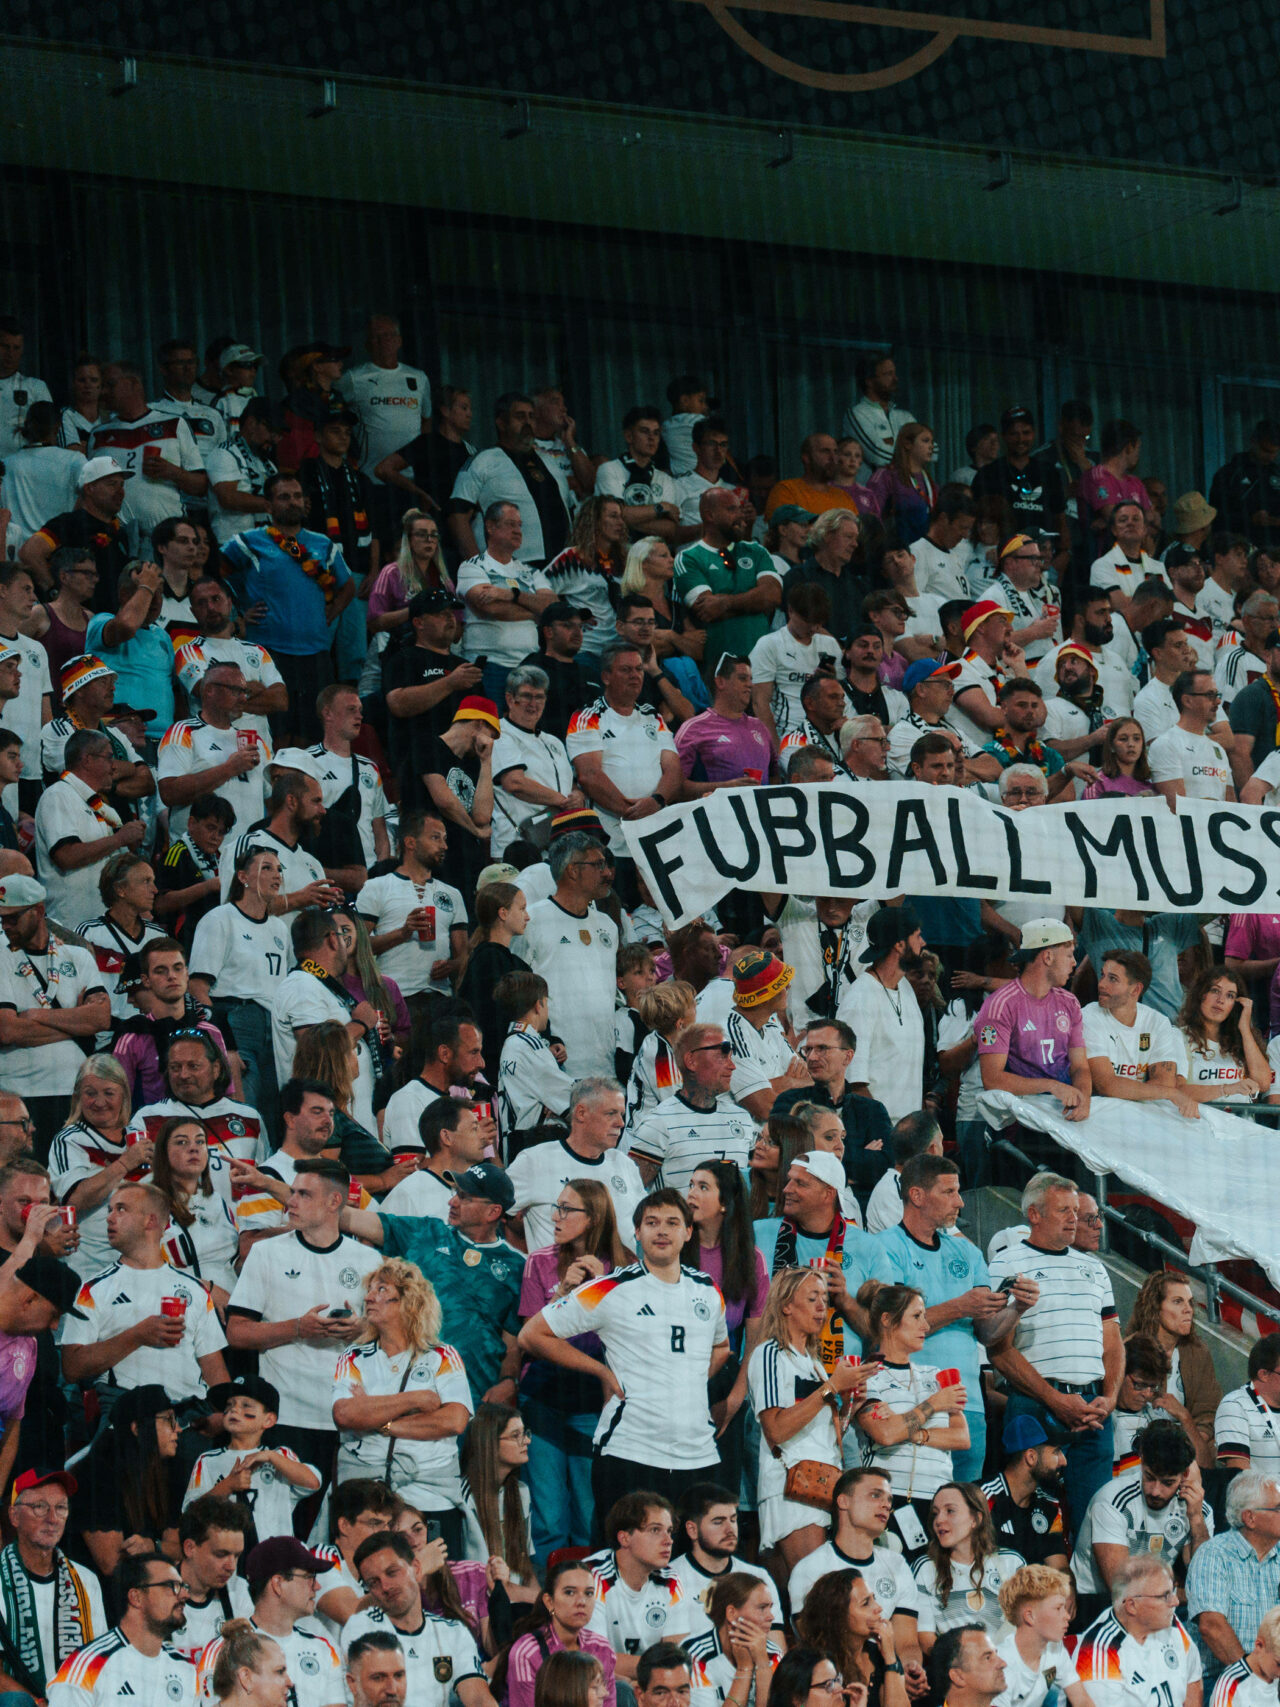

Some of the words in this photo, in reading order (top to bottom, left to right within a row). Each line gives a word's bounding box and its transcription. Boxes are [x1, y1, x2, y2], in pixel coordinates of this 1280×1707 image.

[1012, 502, 1044, 512] adidas
[265, 953, 281, 976] 17
[1040, 1039, 1054, 1065] 17
[671, 1325, 685, 1353] 8
[822, 1340, 833, 1365] 1974
